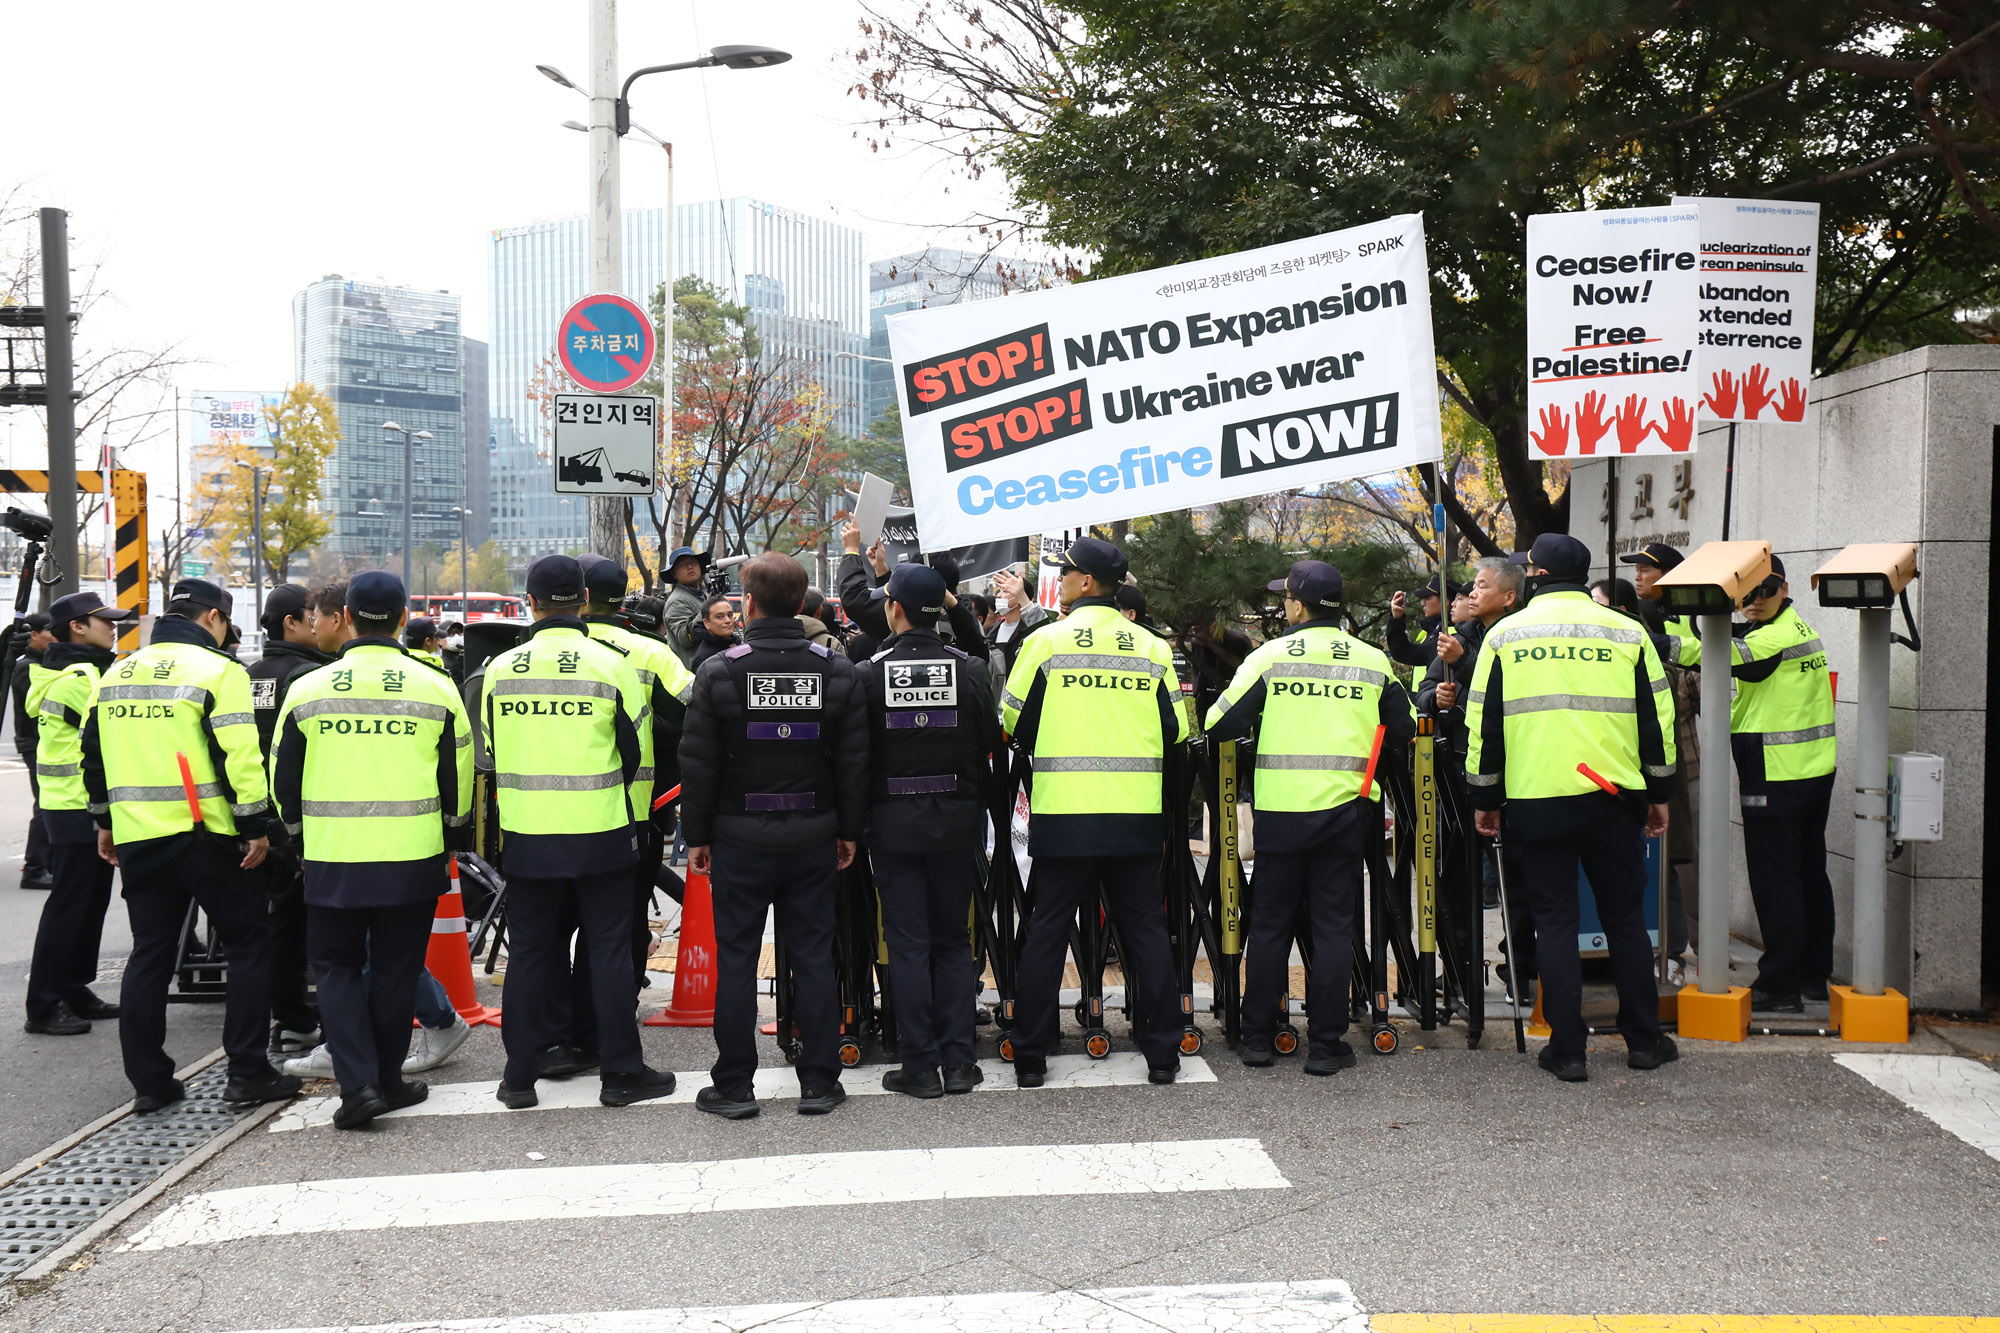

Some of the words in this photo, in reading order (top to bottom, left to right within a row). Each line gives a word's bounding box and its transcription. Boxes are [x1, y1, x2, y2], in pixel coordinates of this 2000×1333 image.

[1669, 213, 1699, 223] (SPARK)
[1270, 256, 1305, 275] 즈음한
[1308, 248, 1351, 267] 피켓팅>
[1358, 235, 1405, 258] SPARK
[1700, 242, 1794, 257] uclearization
[1796, 244, 1812, 257] of
[1536, 248, 1696, 278] Ceasefire
[1736, 259, 1805, 273] peninsula
[1573, 279, 1652, 306] Now!
[1699, 307, 1792, 327] xtended
[572, 332, 641, 355] 주차금지
[913, 333, 1045, 403] STOP!
[1064, 320, 1181, 371] NATO
[1187, 278, 1407, 349] Expansion
[1574, 324, 1647, 347] Free
[1532, 349, 1693, 379] Palestine!
[209, 400, 255, 412] 오늘부터
[558, 401, 653, 425] 견인지역
[950, 388, 1083, 460] STOP!
[1103, 370, 1273, 424] Ukraine
[1279, 348, 1366, 389] war
[958, 446, 1213, 516] Ceasefire
[1237, 400, 1390, 470] NOW!
[1512, 646, 1614, 664] POLICE
[1062, 673, 1151, 691] POLICE
[1272, 681, 1364, 701] POLICE
[253, 697, 271, 706] LICE
[758, 695, 812, 707] POLICE
[892, 690, 953, 702] POLICE
[107, 703, 175, 720] POLICE
[500, 700, 593, 717] POLICE
[319, 719, 418, 736] POLICE
[1223, 776, 1235, 862] POLICE
[1421, 775, 1433, 859] POLICE
[1226, 876, 1237, 932] LINE
[1423, 875, 1433, 930] LINE
